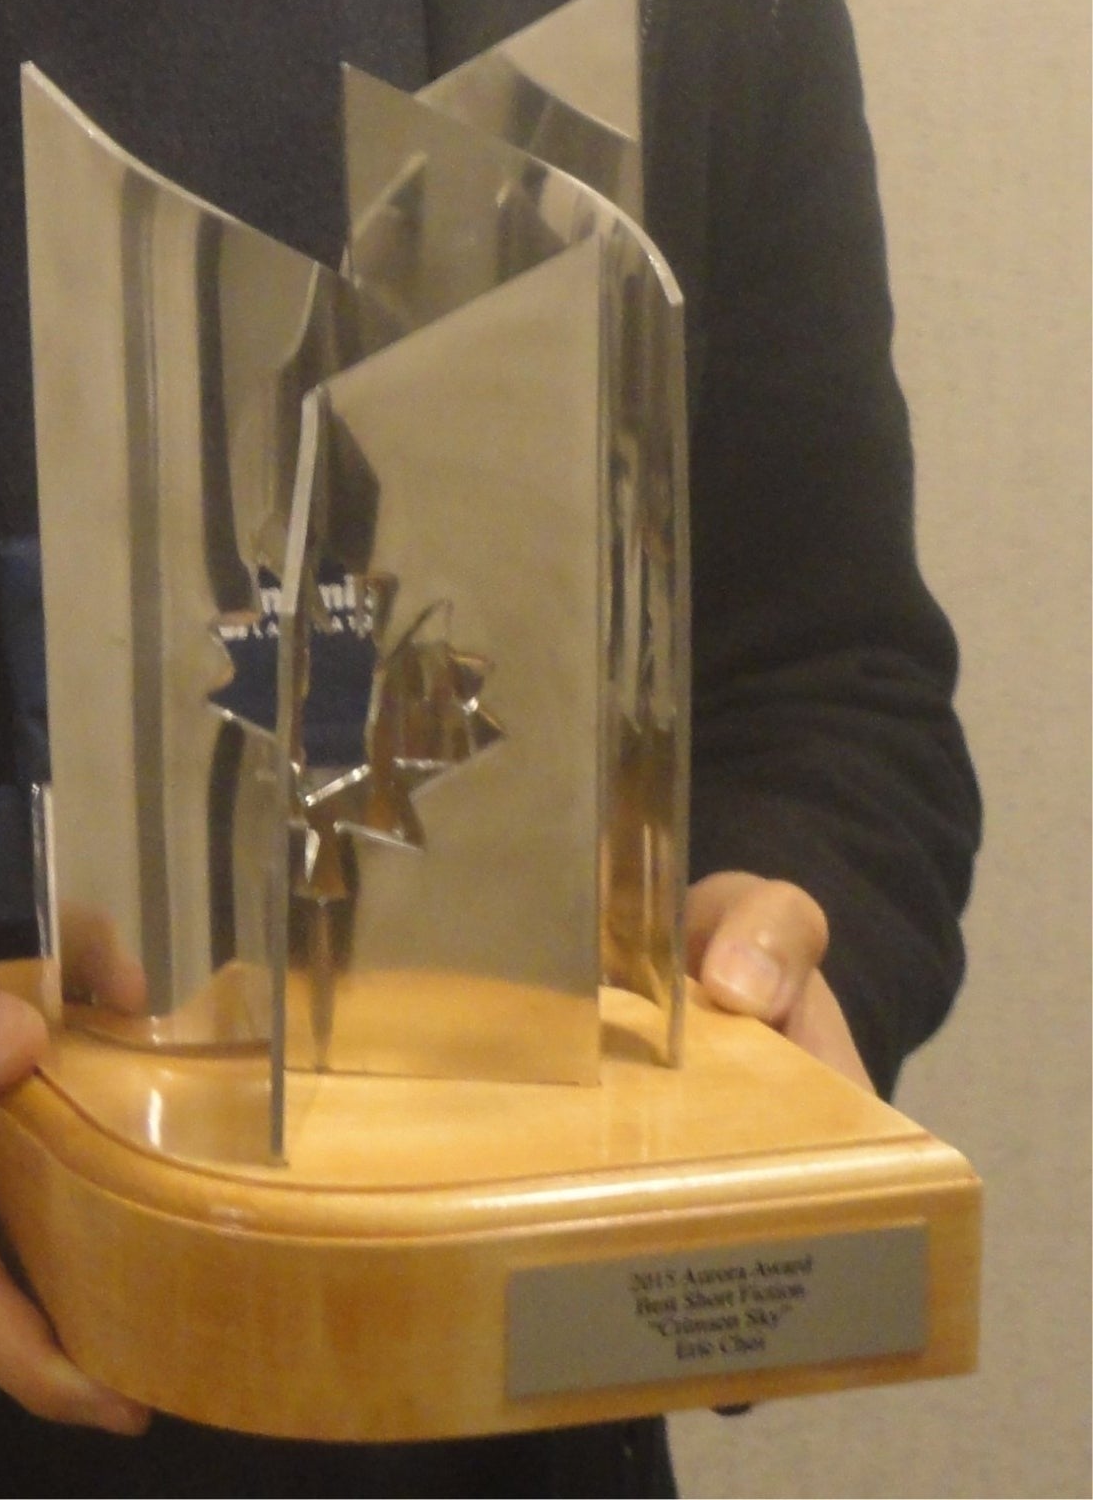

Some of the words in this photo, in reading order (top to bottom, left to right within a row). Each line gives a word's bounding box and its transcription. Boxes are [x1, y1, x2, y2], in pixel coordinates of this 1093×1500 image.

[683, 1267, 747, 1285] Aurora
[751, 1254, 813, 1276] Award
[635, 1296, 677, 1315] Best
[684, 1291, 734, 1309] Short
[739, 1284, 805, 1303] Fiction
